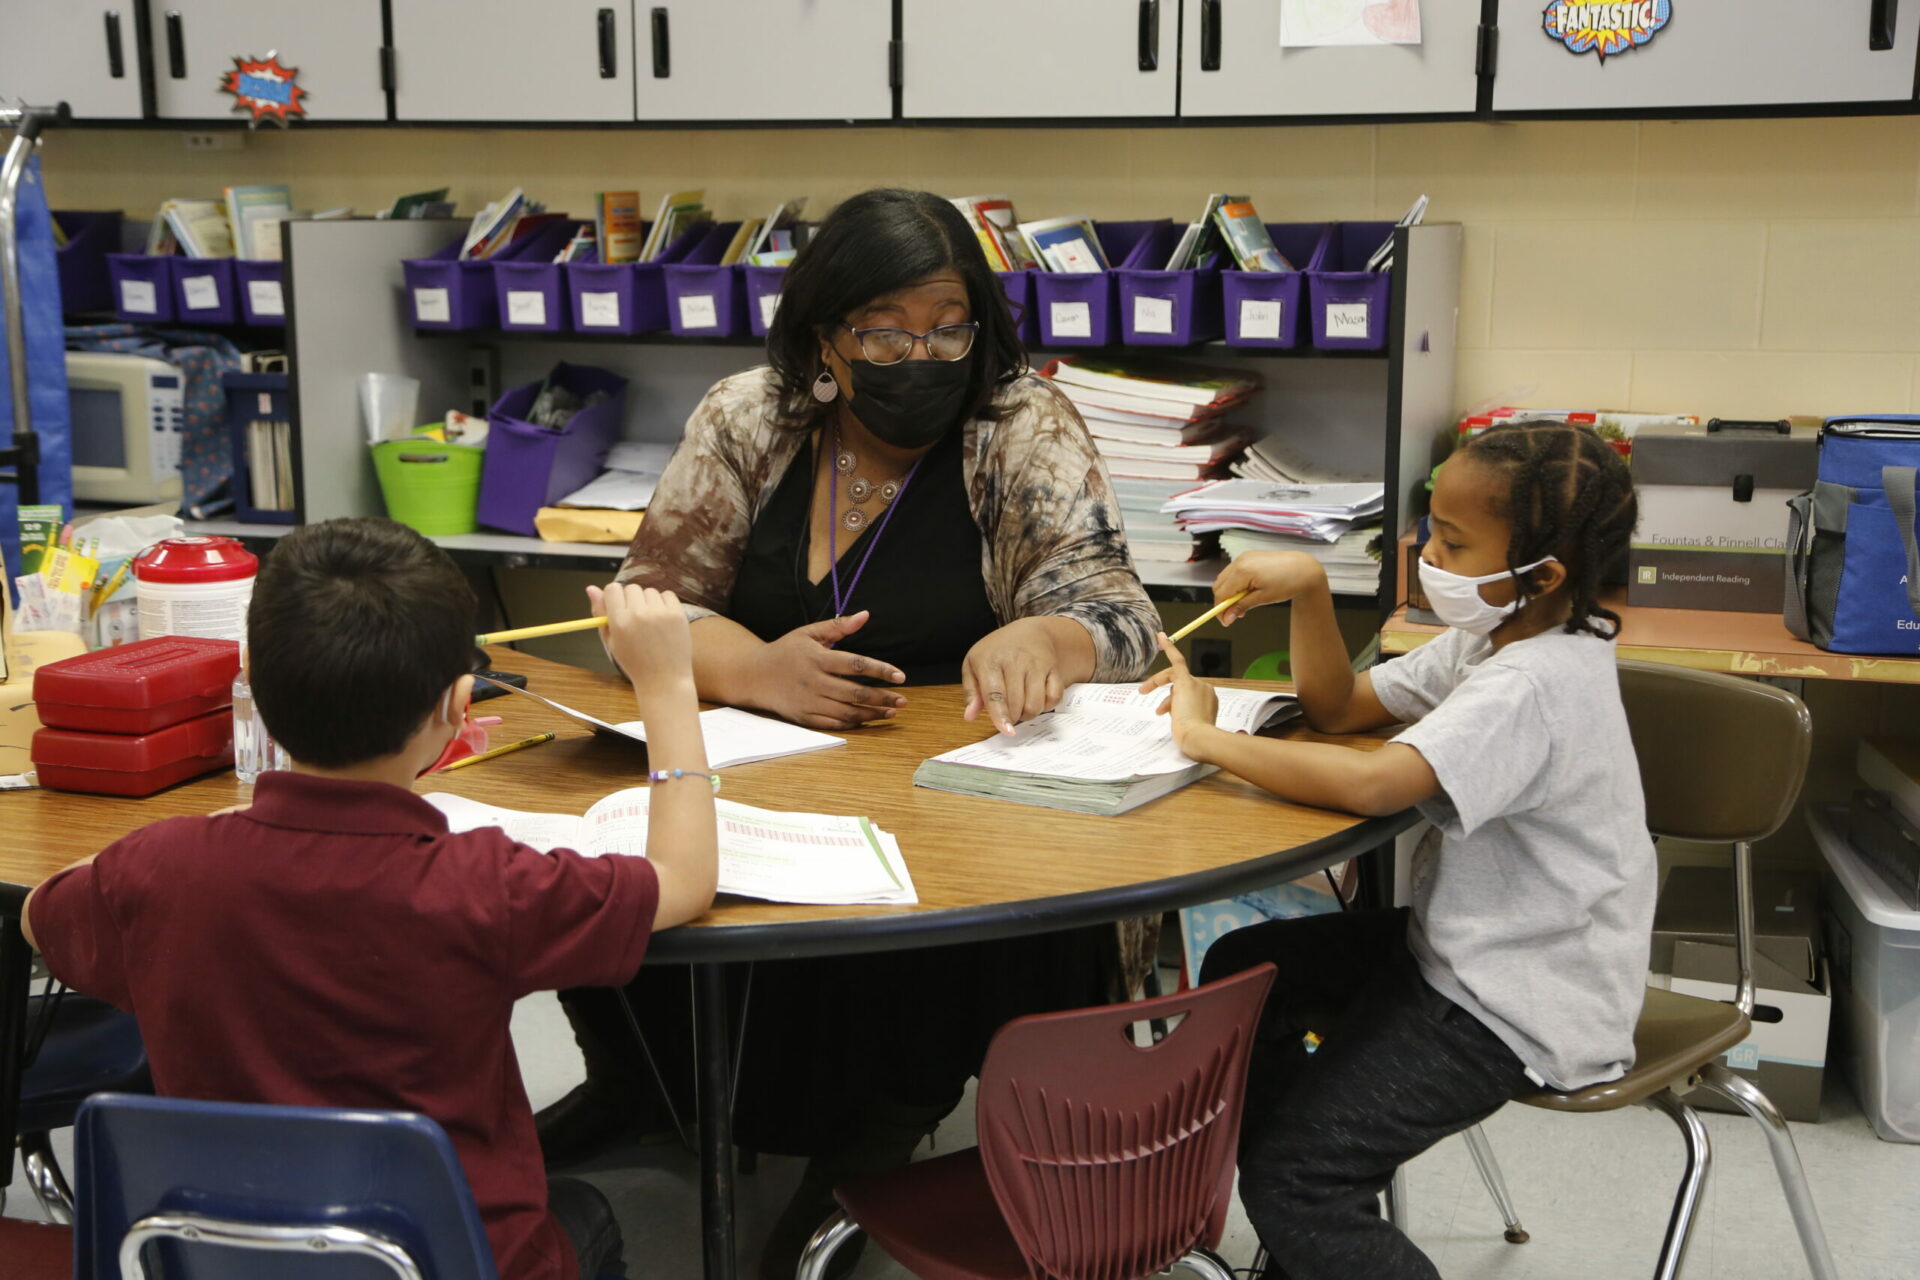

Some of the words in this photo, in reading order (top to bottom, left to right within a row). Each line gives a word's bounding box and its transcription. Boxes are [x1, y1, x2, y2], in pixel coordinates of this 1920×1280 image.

[1556, 0, 1659, 33] FANTASTIC!
[1651, 533, 1701, 545] Fountas
[1704, 535, 1715, 547] &
[1718, 536, 1760, 548] Pinnell
[1662, 572, 1714, 582] Independent
[1716, 574, 1750, 585] Reading
[1732, 1047, 1754, 1063] GR
